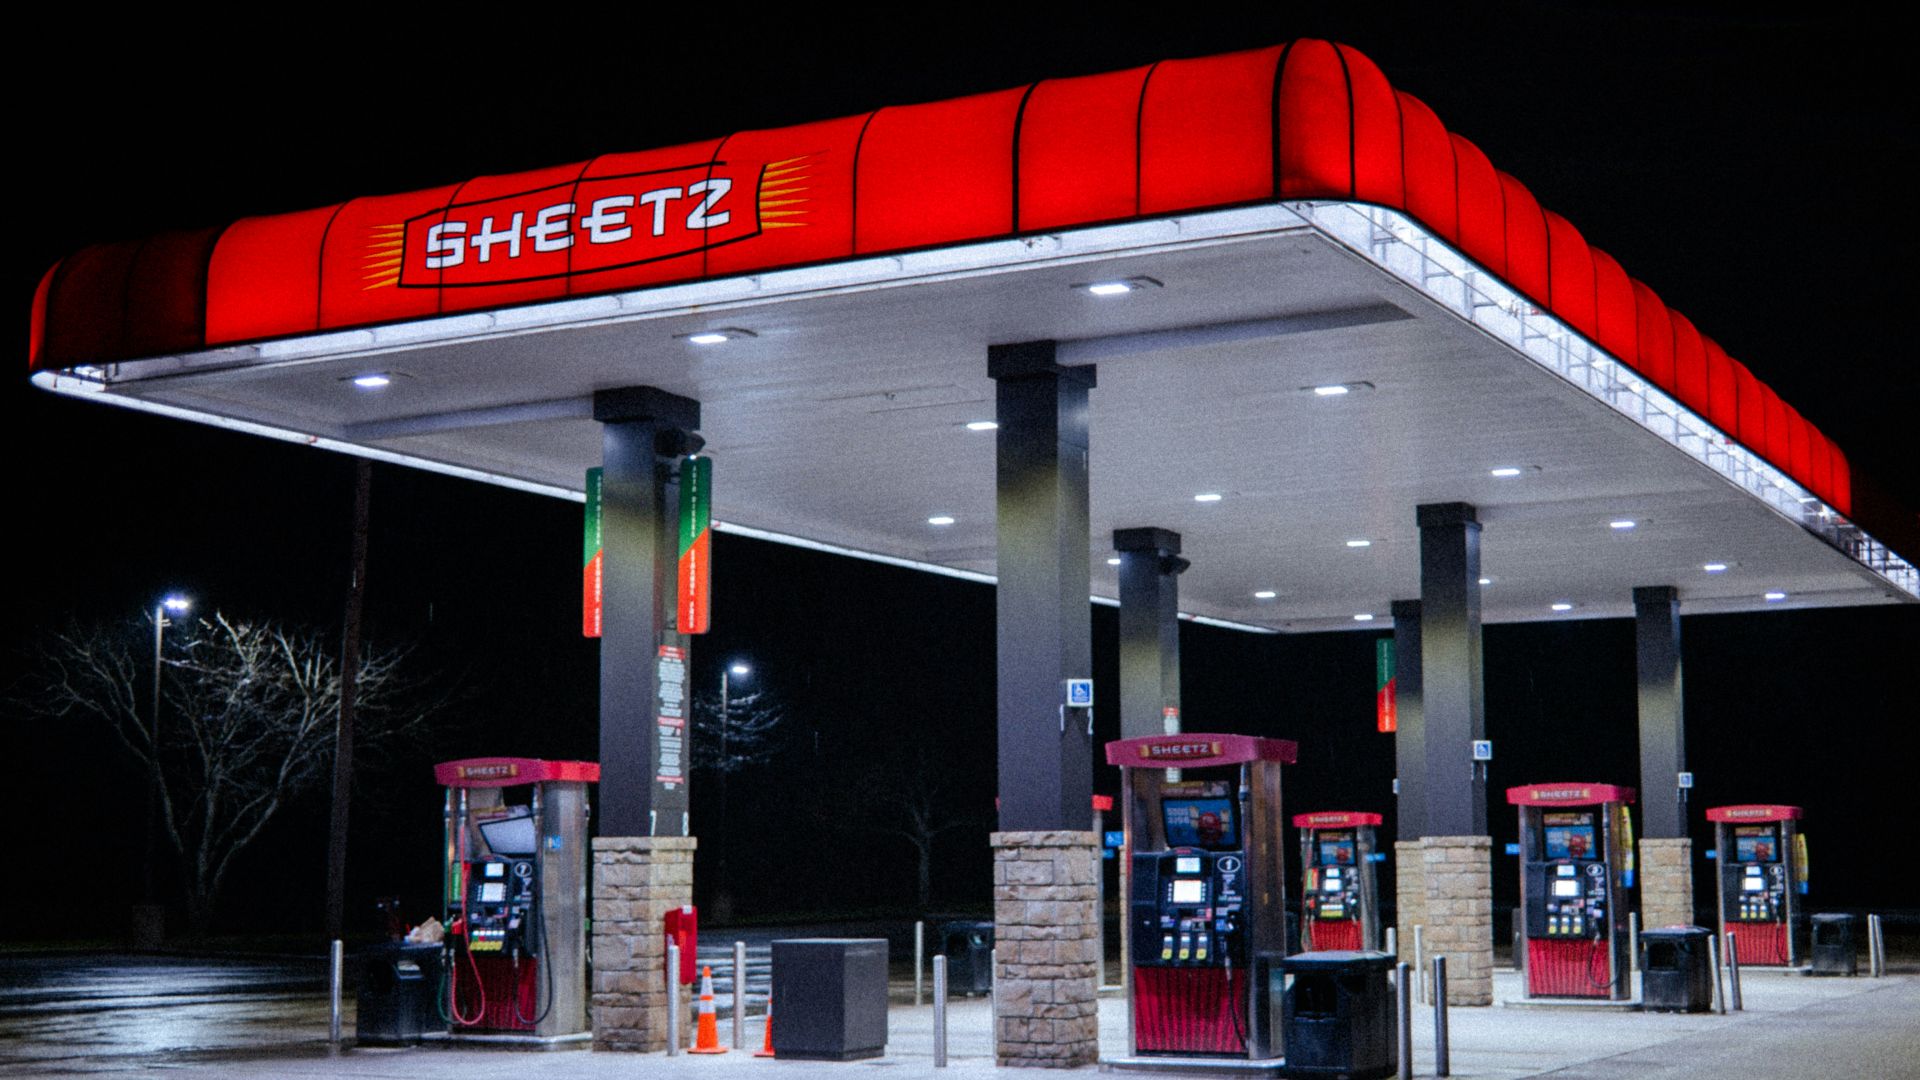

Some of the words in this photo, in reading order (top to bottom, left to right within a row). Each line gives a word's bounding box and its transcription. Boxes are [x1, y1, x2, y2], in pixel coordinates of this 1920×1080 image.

[425, 178, 732, 267] SHEETZ
[1152, 744, 1209, 756] SHEETZ
[466, 767, 508, 776] SHEETZ
[1225, 859, 1233, 870] 1
